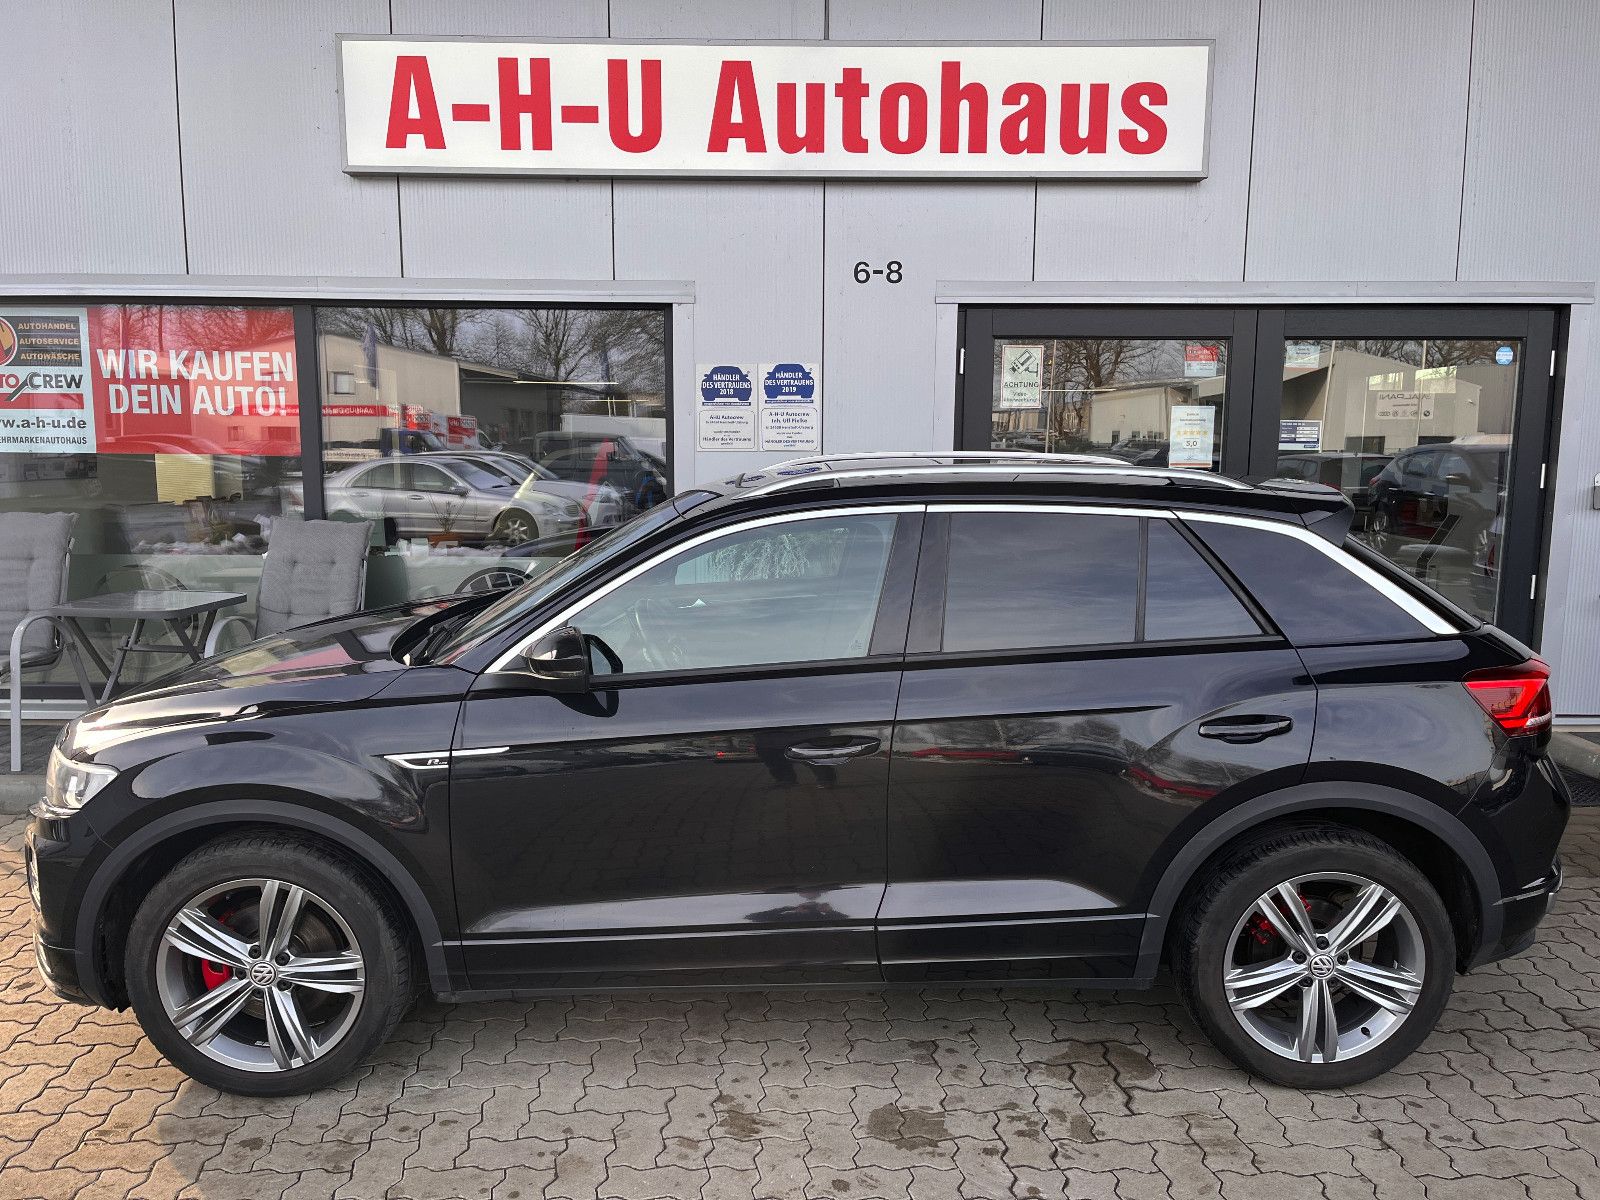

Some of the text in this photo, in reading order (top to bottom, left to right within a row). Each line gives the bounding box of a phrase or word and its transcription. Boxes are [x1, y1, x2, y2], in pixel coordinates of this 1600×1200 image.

[385, 55, 1168, 155] A-H-U Autohaus
[853, 260, 904, 284] 6-8
[20, 352, 80, 360] AUTOWÄSCHE
[96, 348, 294, 382] WIR KAUFEN
[108, 383, 287, 416] DEIN AUTO!
